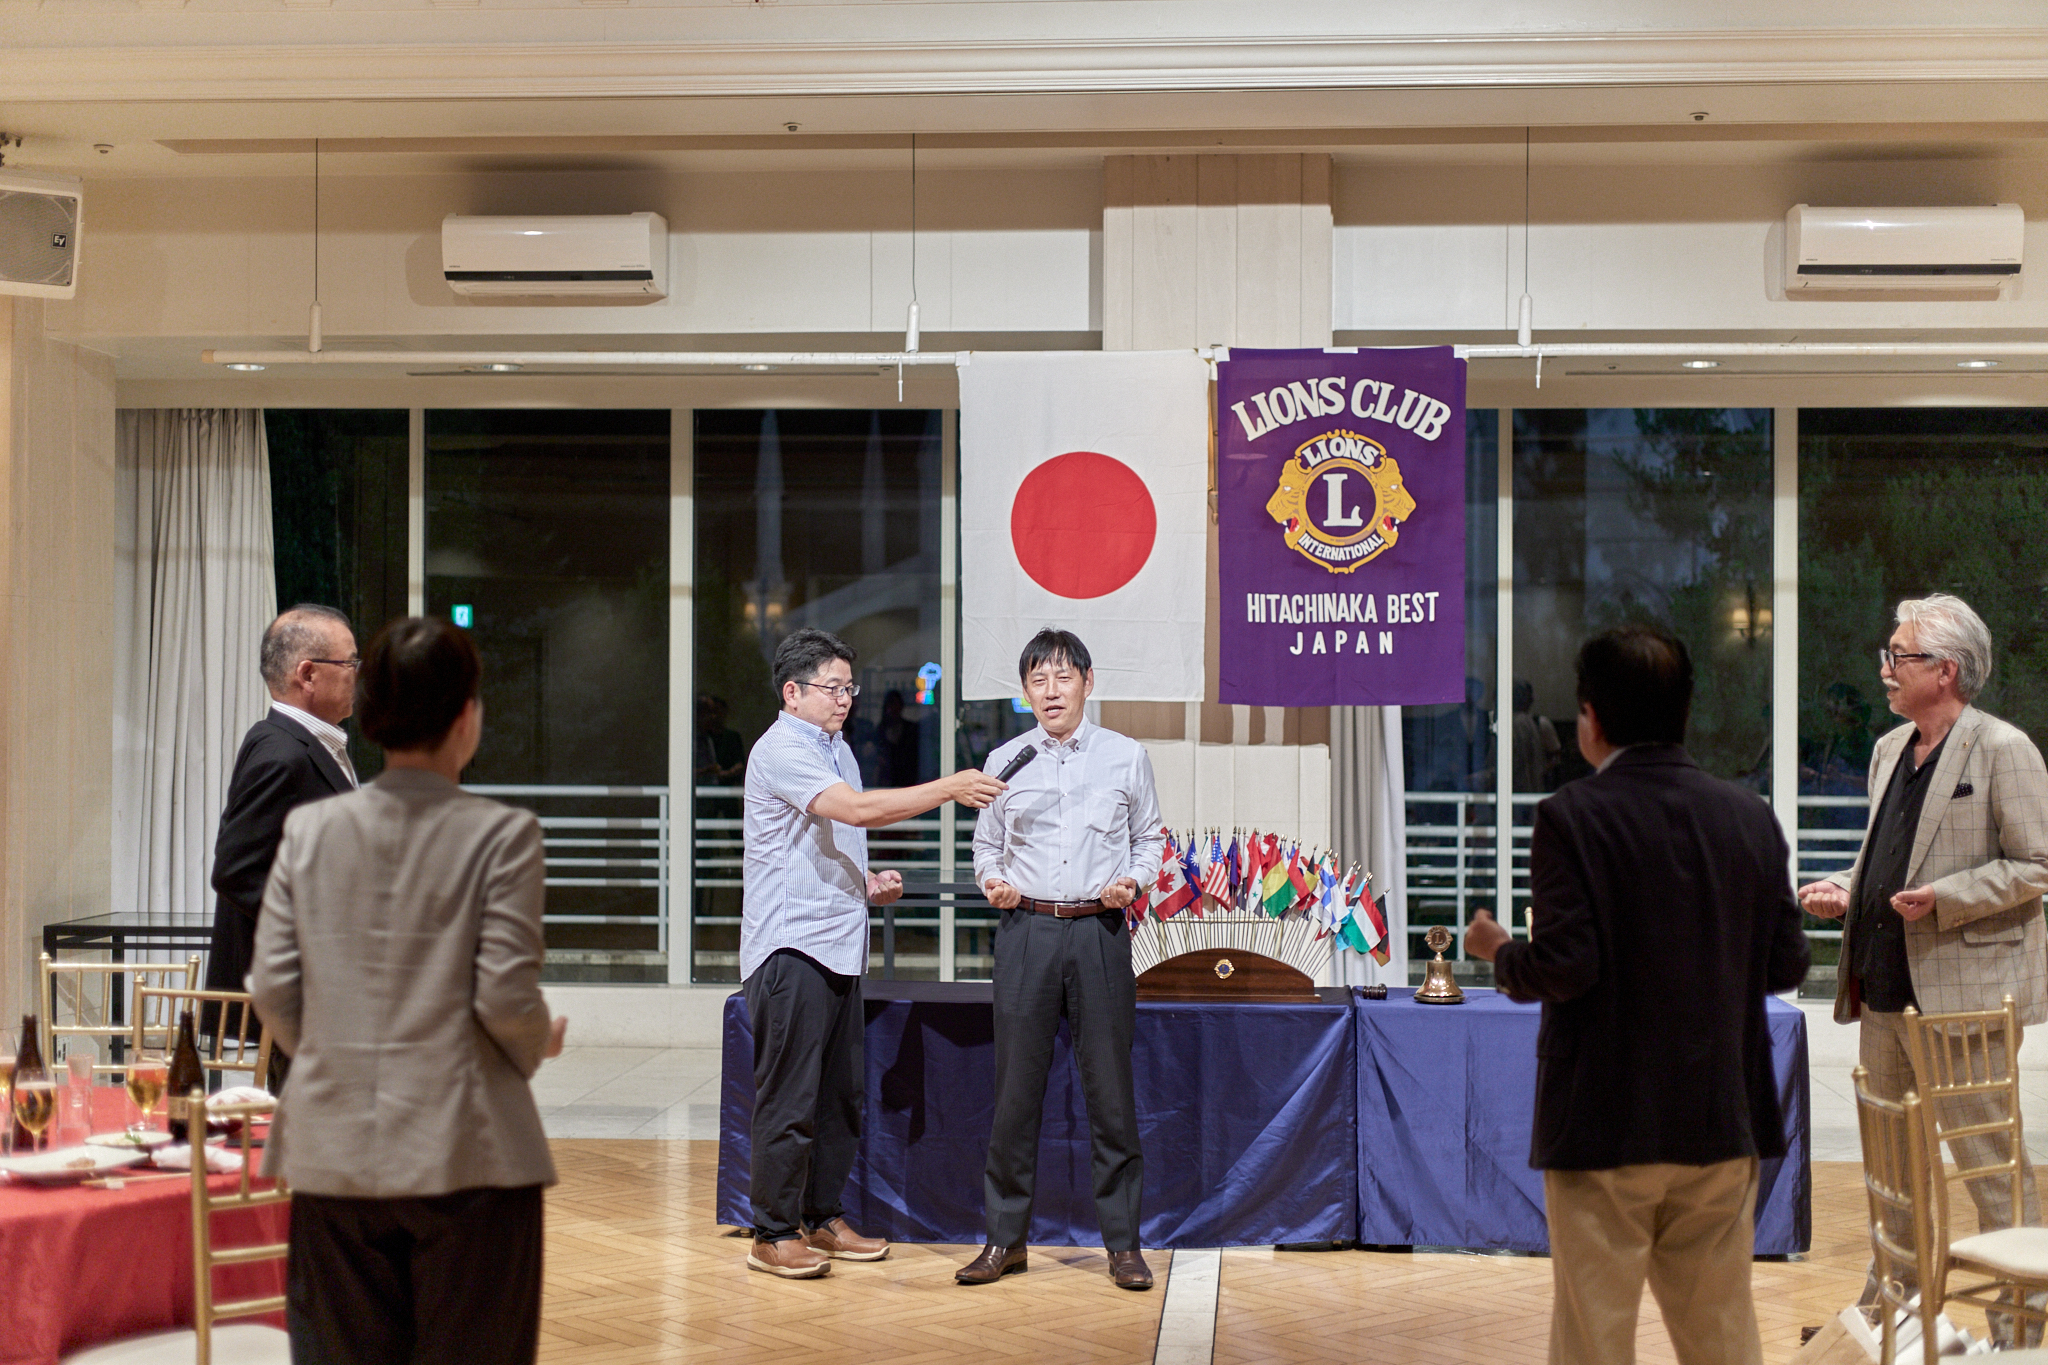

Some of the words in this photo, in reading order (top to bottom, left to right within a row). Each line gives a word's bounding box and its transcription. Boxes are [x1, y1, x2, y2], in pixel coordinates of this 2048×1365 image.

[1231, 376, 1346, 442] LIONS
[1350, 378, 1452, 442] CLUB
[1301, 436, 1380, 468] LIONS
[1322, 473, 1364, 527] L
[1297, 533, 1385, 561] INTERNATIONAL
[1247, 592, 1378, 624] HITACHINAKA
[1387, 592, 1440, 624] BEST
[1289, 629, 1393, 655] JAPAN
[1434, 933, 1444, 945] L
